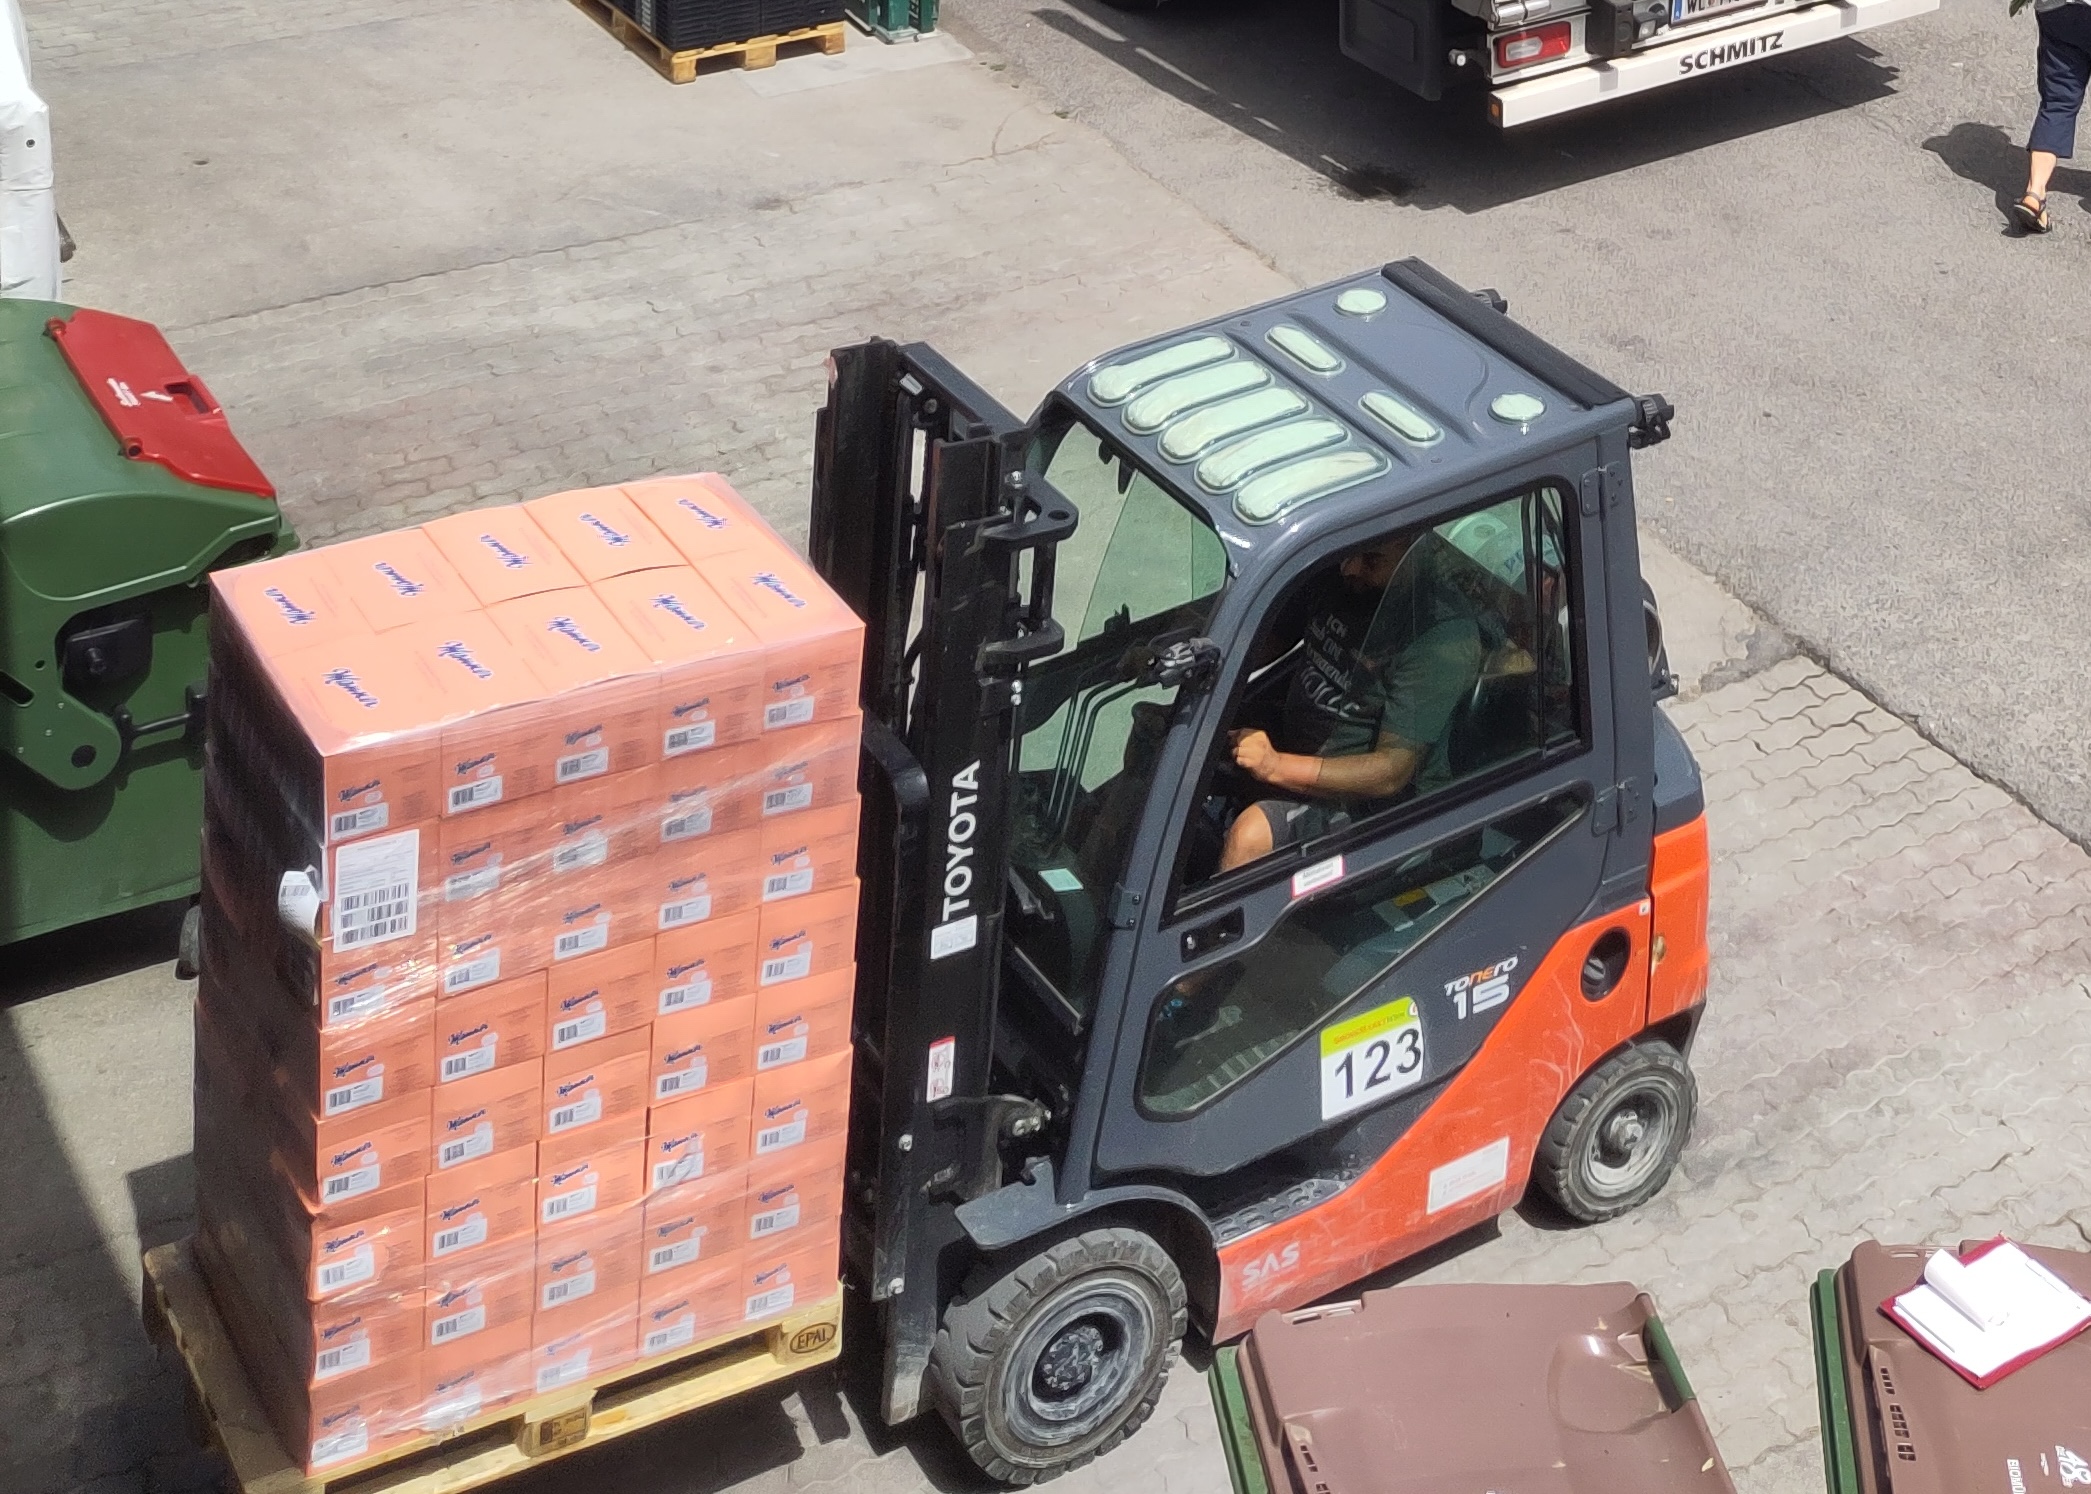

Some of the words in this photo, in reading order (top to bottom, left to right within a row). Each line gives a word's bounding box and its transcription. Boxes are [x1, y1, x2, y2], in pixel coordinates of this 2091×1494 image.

[1680, 31, 1784, 75] SCHMITZ
[942, 759, 981, 922] TOYOTA
[1453, 973, 1510, 1020] 15
[1334, 1028, 1423, 1099] 123
[1241, 1243, 1301, 1289] SAS
